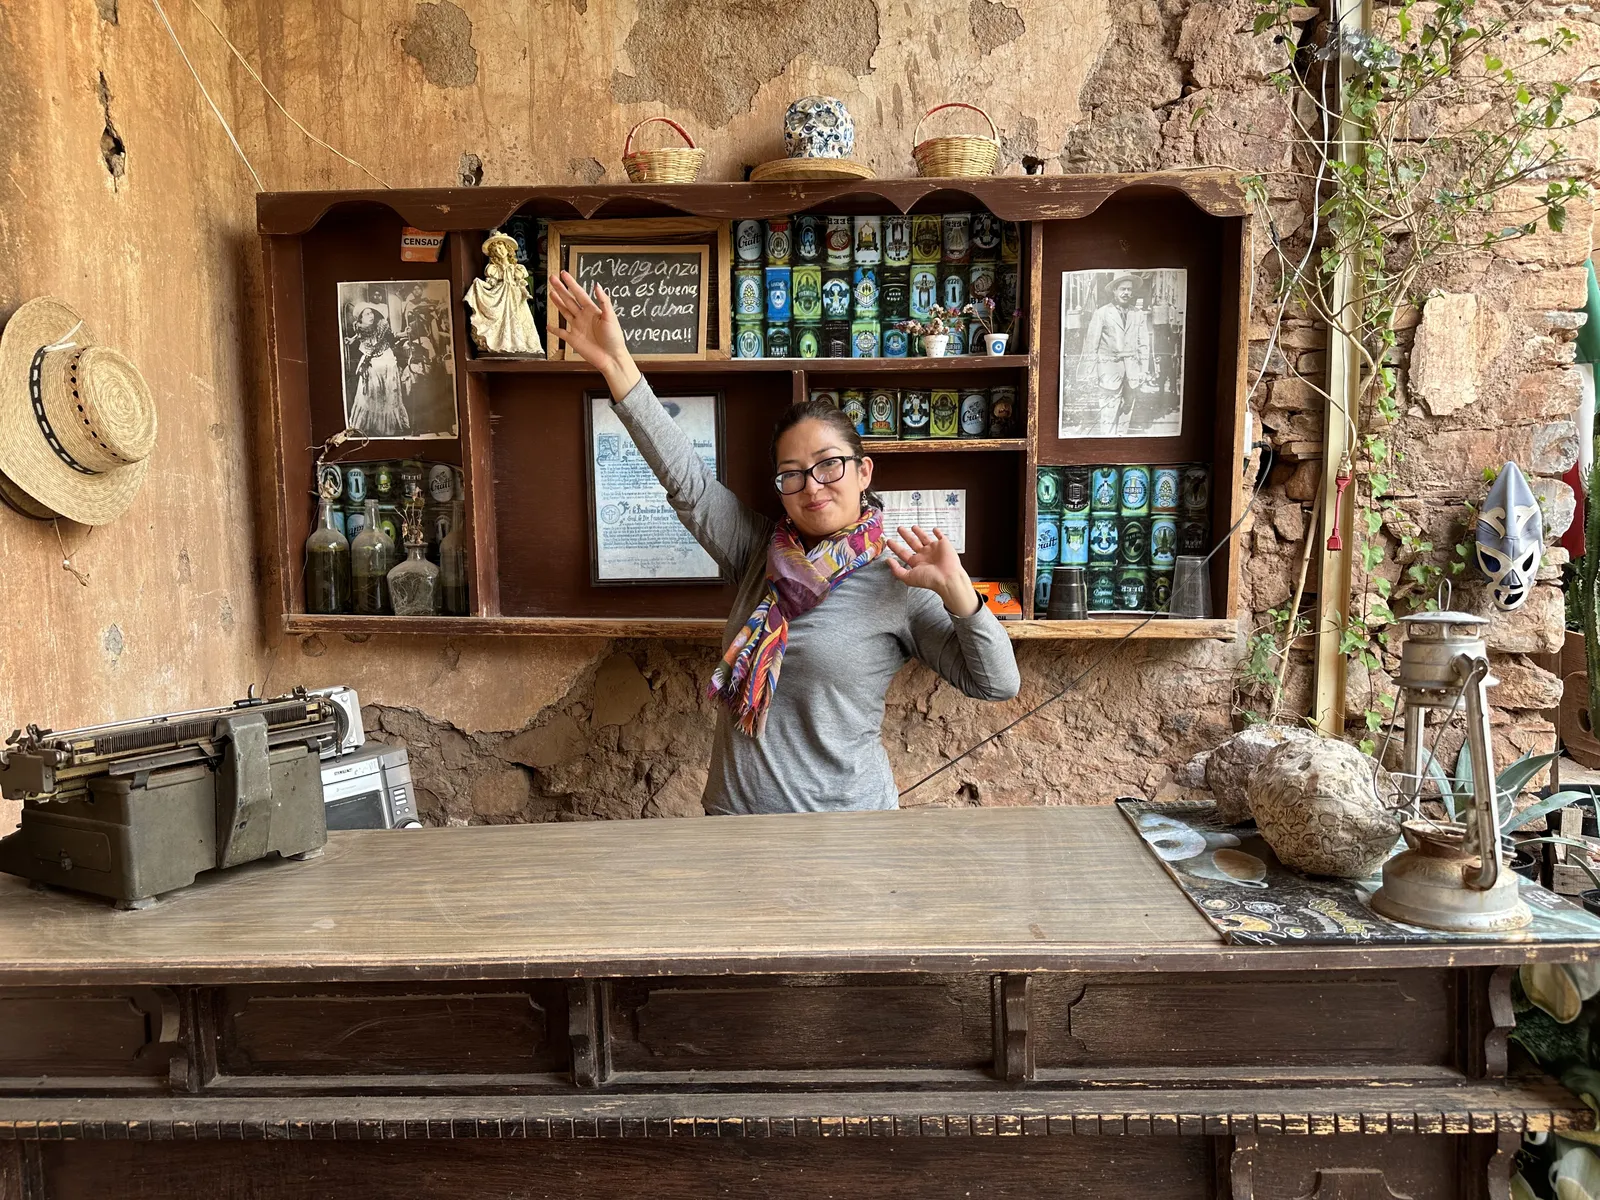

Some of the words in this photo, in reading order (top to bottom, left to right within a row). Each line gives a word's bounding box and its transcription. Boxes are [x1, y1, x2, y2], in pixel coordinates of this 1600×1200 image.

[738, 234, 761, 248] Craft
[579, 256, 604, 278] La
[635, 282, 654, 298] es
[630, 299, 648, 318] el
[650, 297, 694, 318] alma
[623, 327, 692, 343] venena!!
[963, 411, 985, 423] Craft
